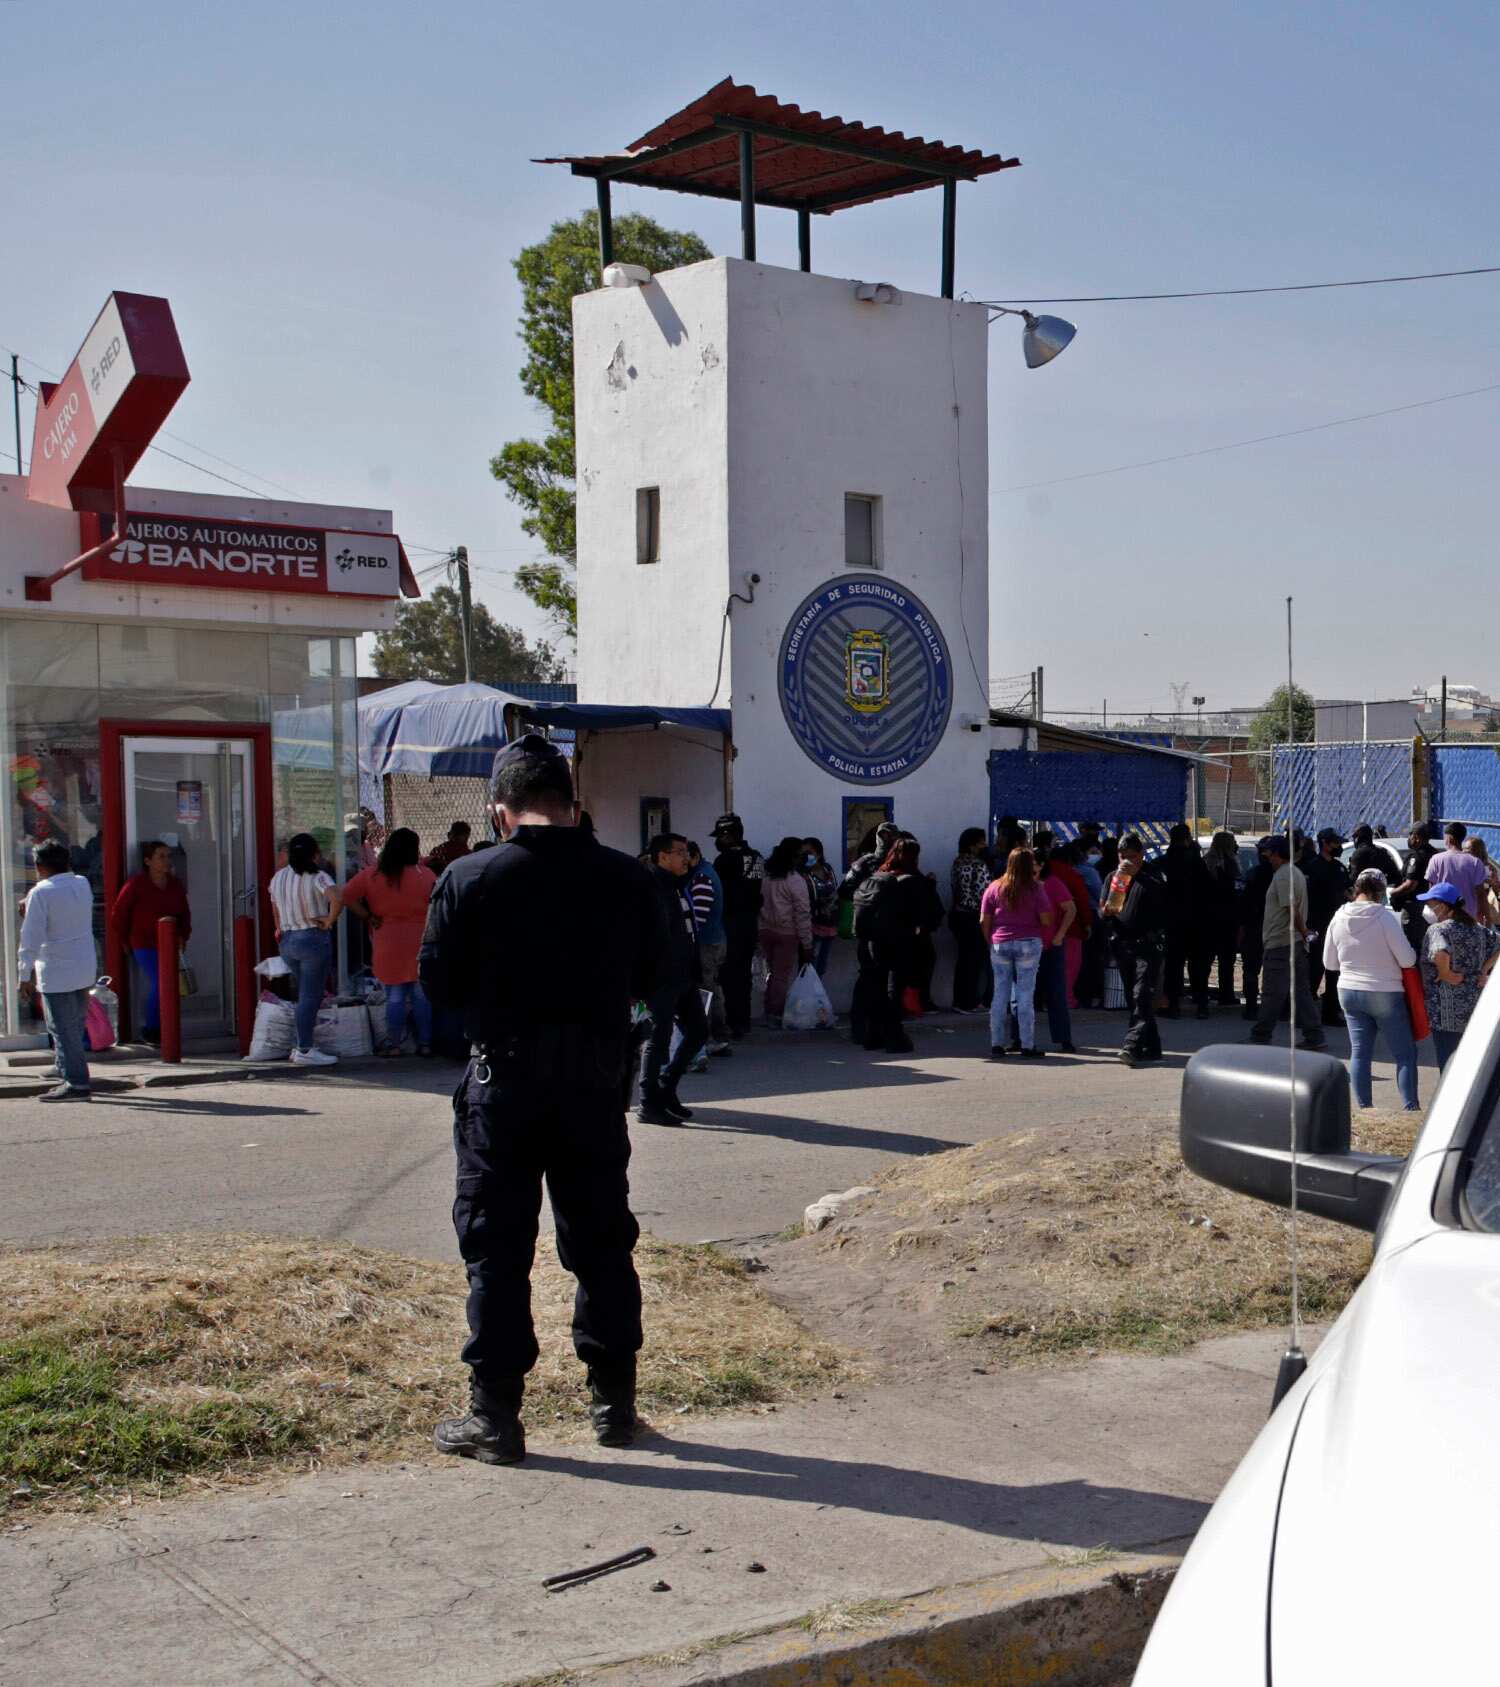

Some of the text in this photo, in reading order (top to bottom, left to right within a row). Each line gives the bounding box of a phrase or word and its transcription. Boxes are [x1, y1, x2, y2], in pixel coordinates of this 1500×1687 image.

[99, 337, 121, 377] RED
[43, 392, 79, 459] CAJERO
[112, 521, 317, 551] AJEROS AUTOMATICOS
[148, 544, 318, 578] BANORTE
[357, 555, 389, 569] RED
[828, 588, 841, 601] DE
[848, 584, 905, 607] SEGURIDAD
[870, 758, 908, 776] ESTATAL
